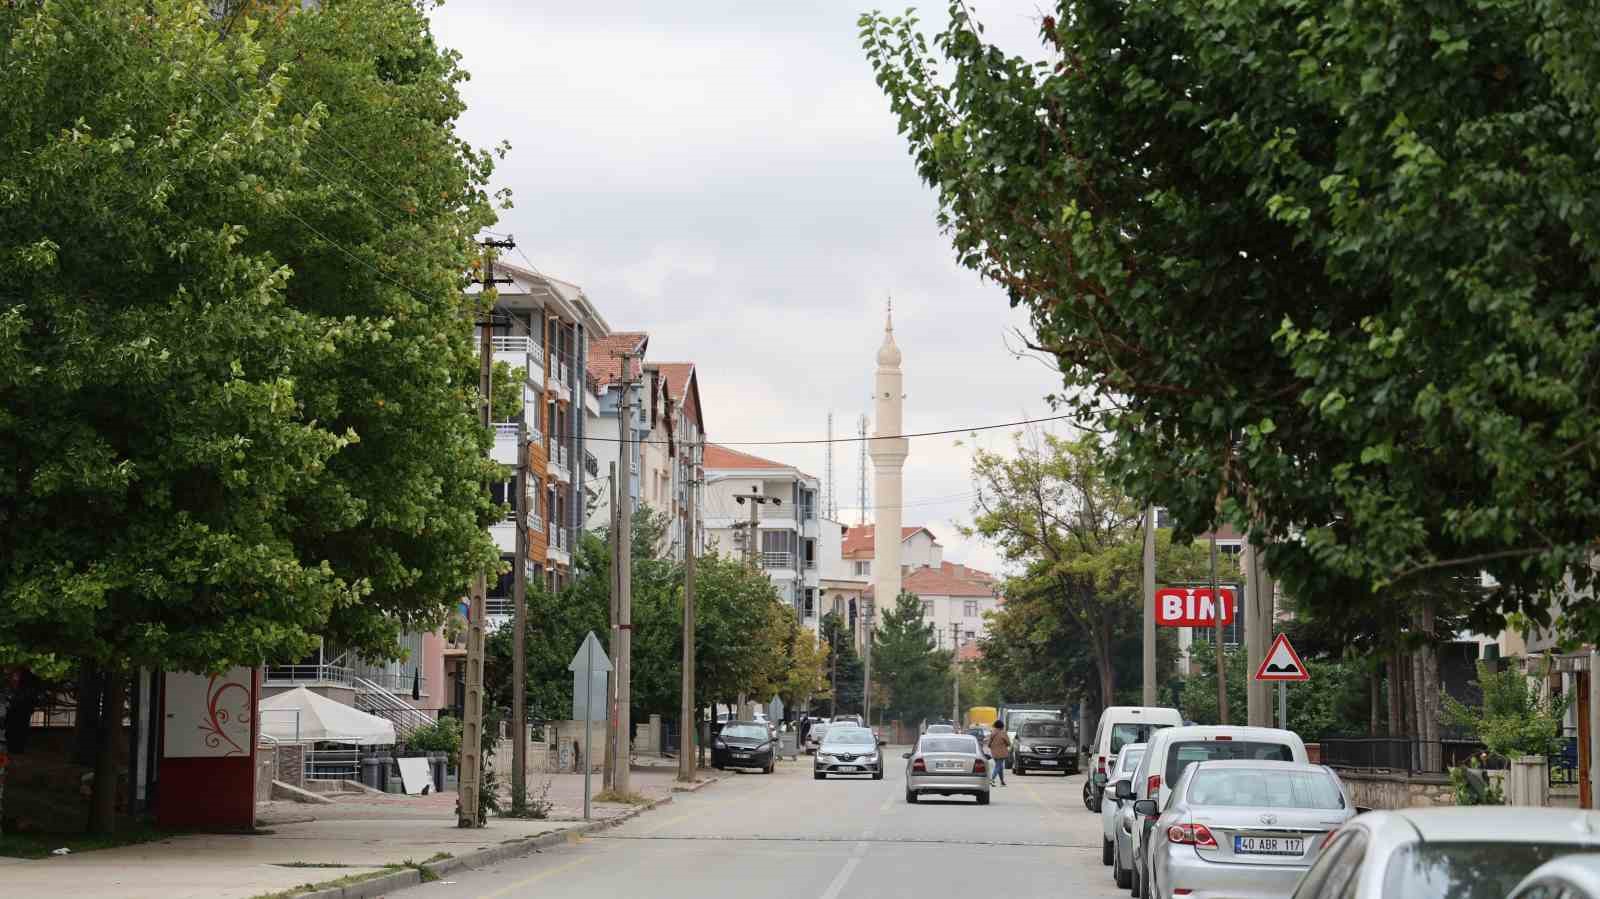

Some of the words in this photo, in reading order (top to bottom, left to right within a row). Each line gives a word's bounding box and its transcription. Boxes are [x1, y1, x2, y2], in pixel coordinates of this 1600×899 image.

[1162, 589, 1226, 620] BİM
[1241, 838, 1255, 850] 40
[1259, 839, 1278, 850] ABR
[1285, 839, 1300, 851] 117
